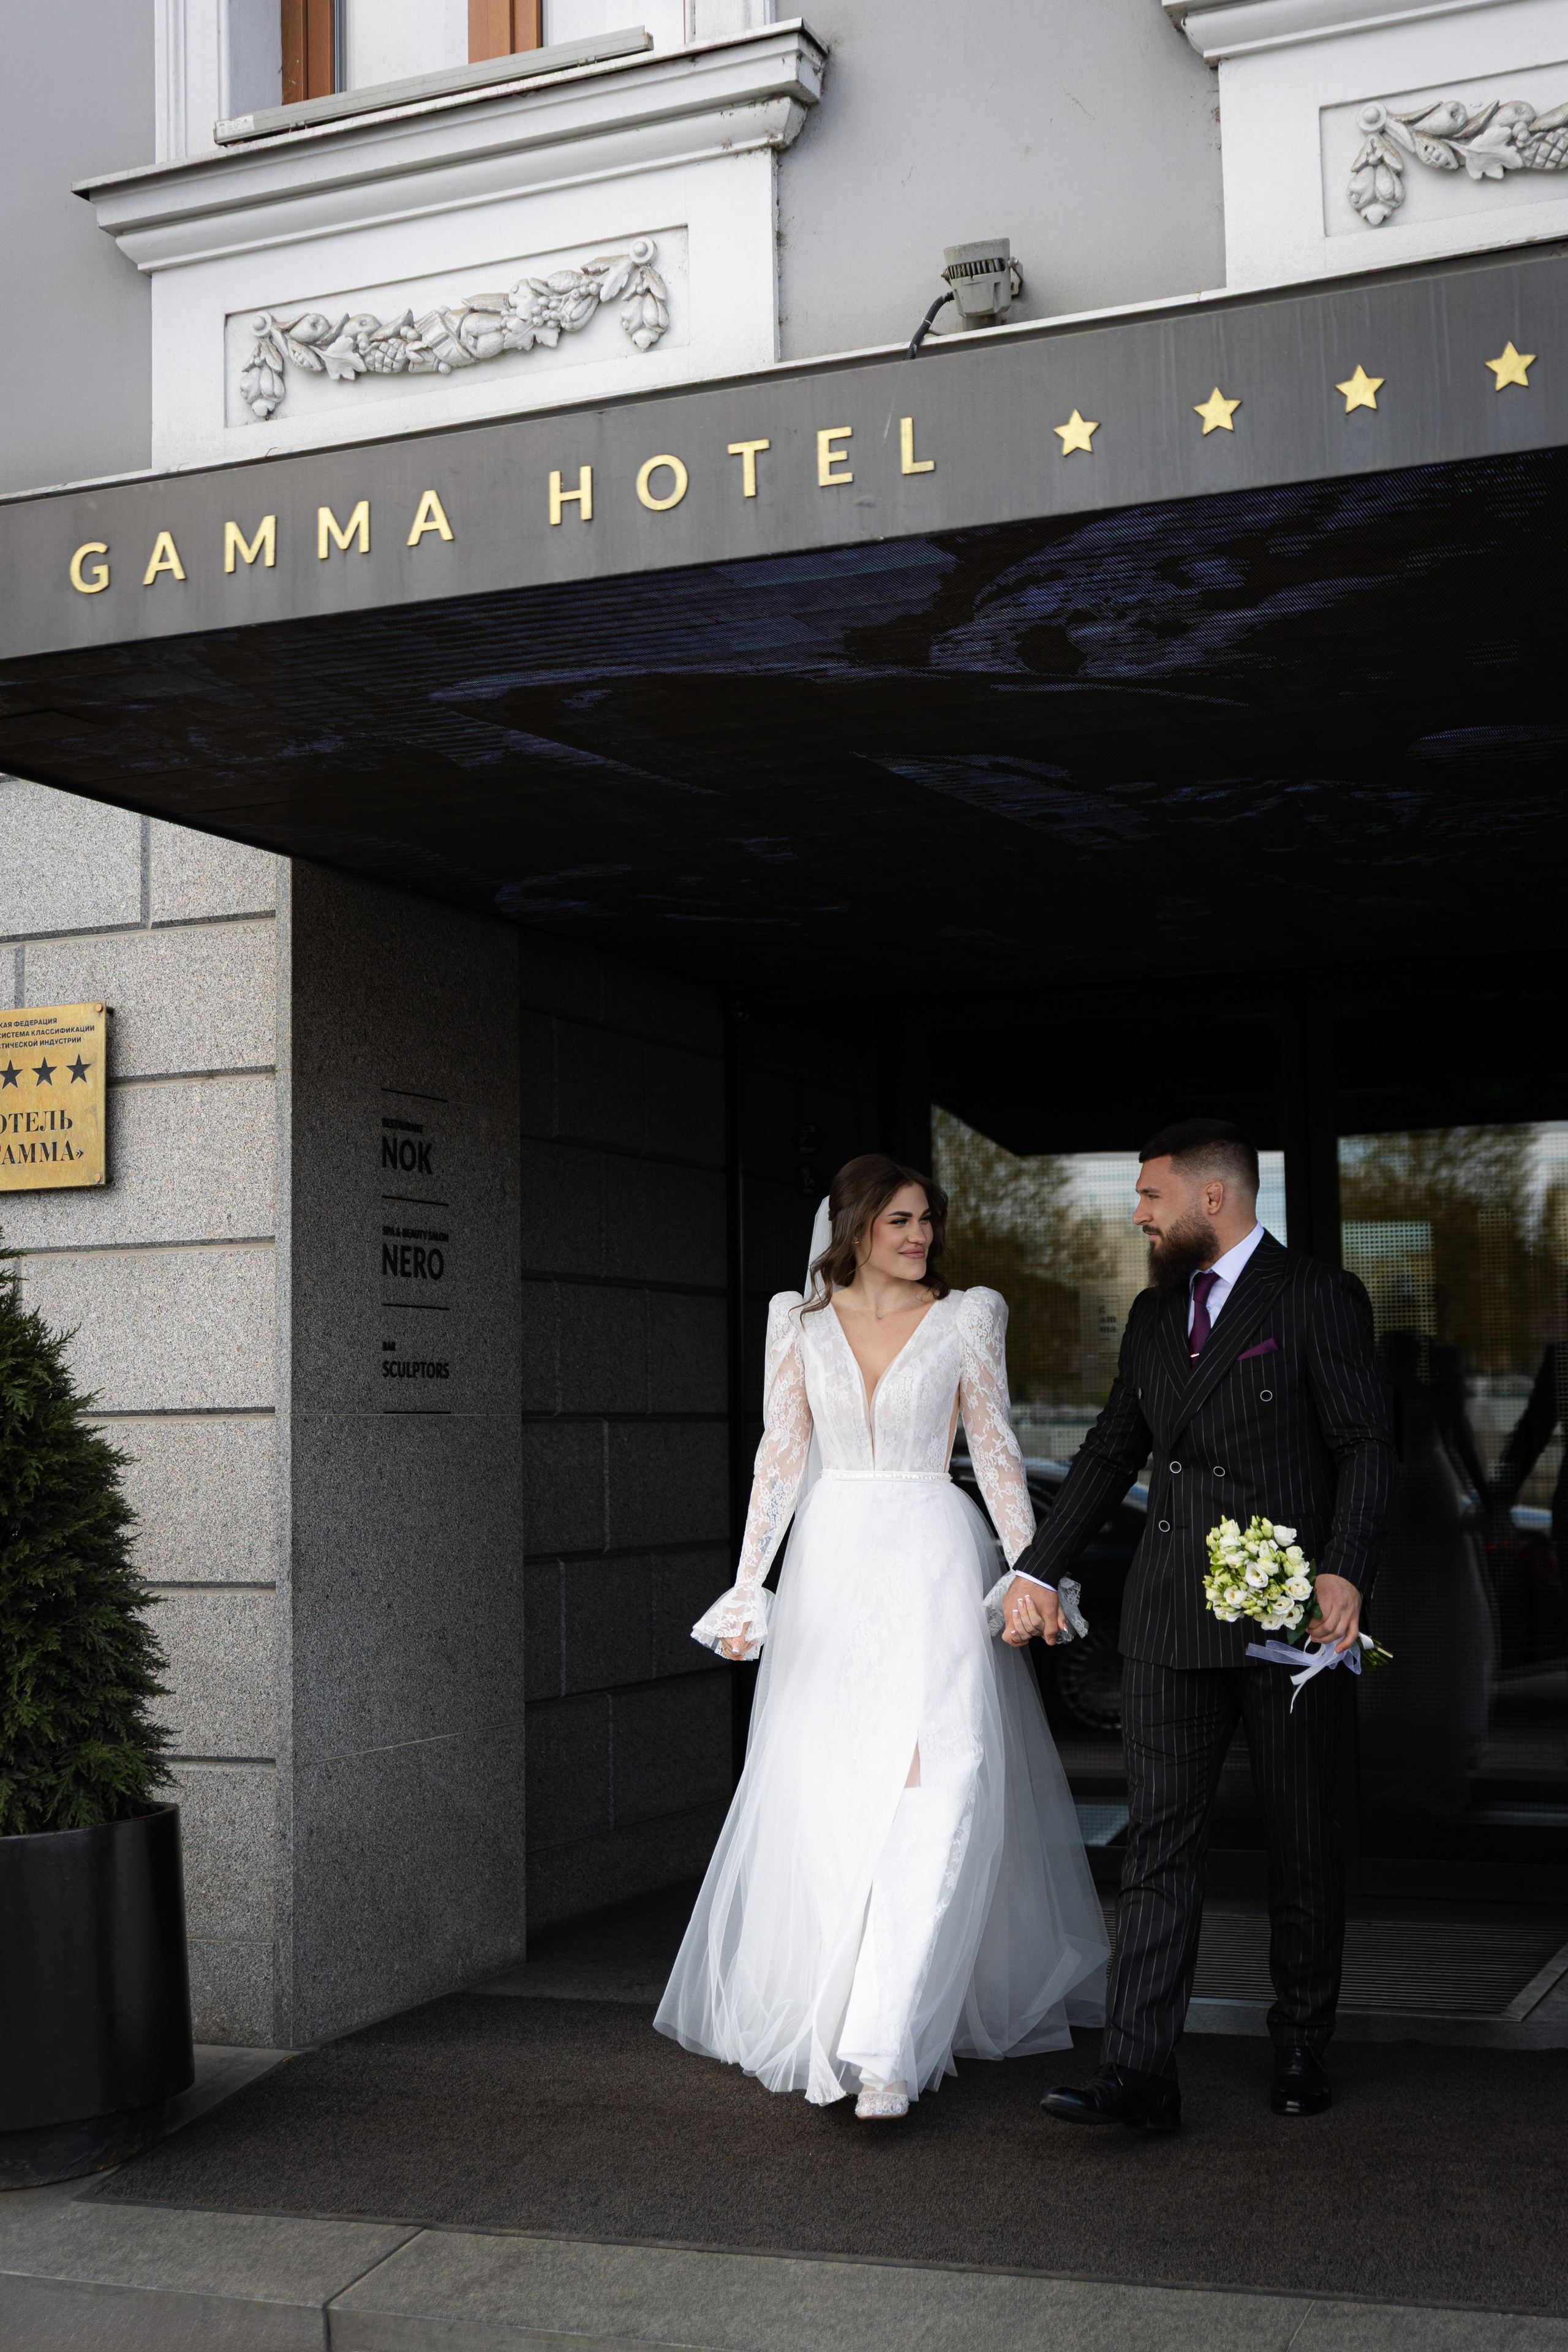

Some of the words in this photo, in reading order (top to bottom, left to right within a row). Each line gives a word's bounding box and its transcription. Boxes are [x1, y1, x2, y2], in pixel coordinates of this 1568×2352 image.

[69, 489, 453, 594] GAMMA
[549, 417, 935, 526] HOTEL
[13, 1018, 57, 1027] ФЕДЕРАЦИЯ
[31, 1025, 95, 1036] КЛАССИФИКАЦИИ
[0, 1039, 38, 1049] ТИЧЕСКОЙ
[40, 1037, 81, 1046] ИНДУСТРИИ
[0, 1140, 84, 1164] АММА»
[382, 1135, 432, 1174] NOK
[382, 1243, 444, 1280] NERO
[382, 1360, 450, 1379] SCULPTORS
